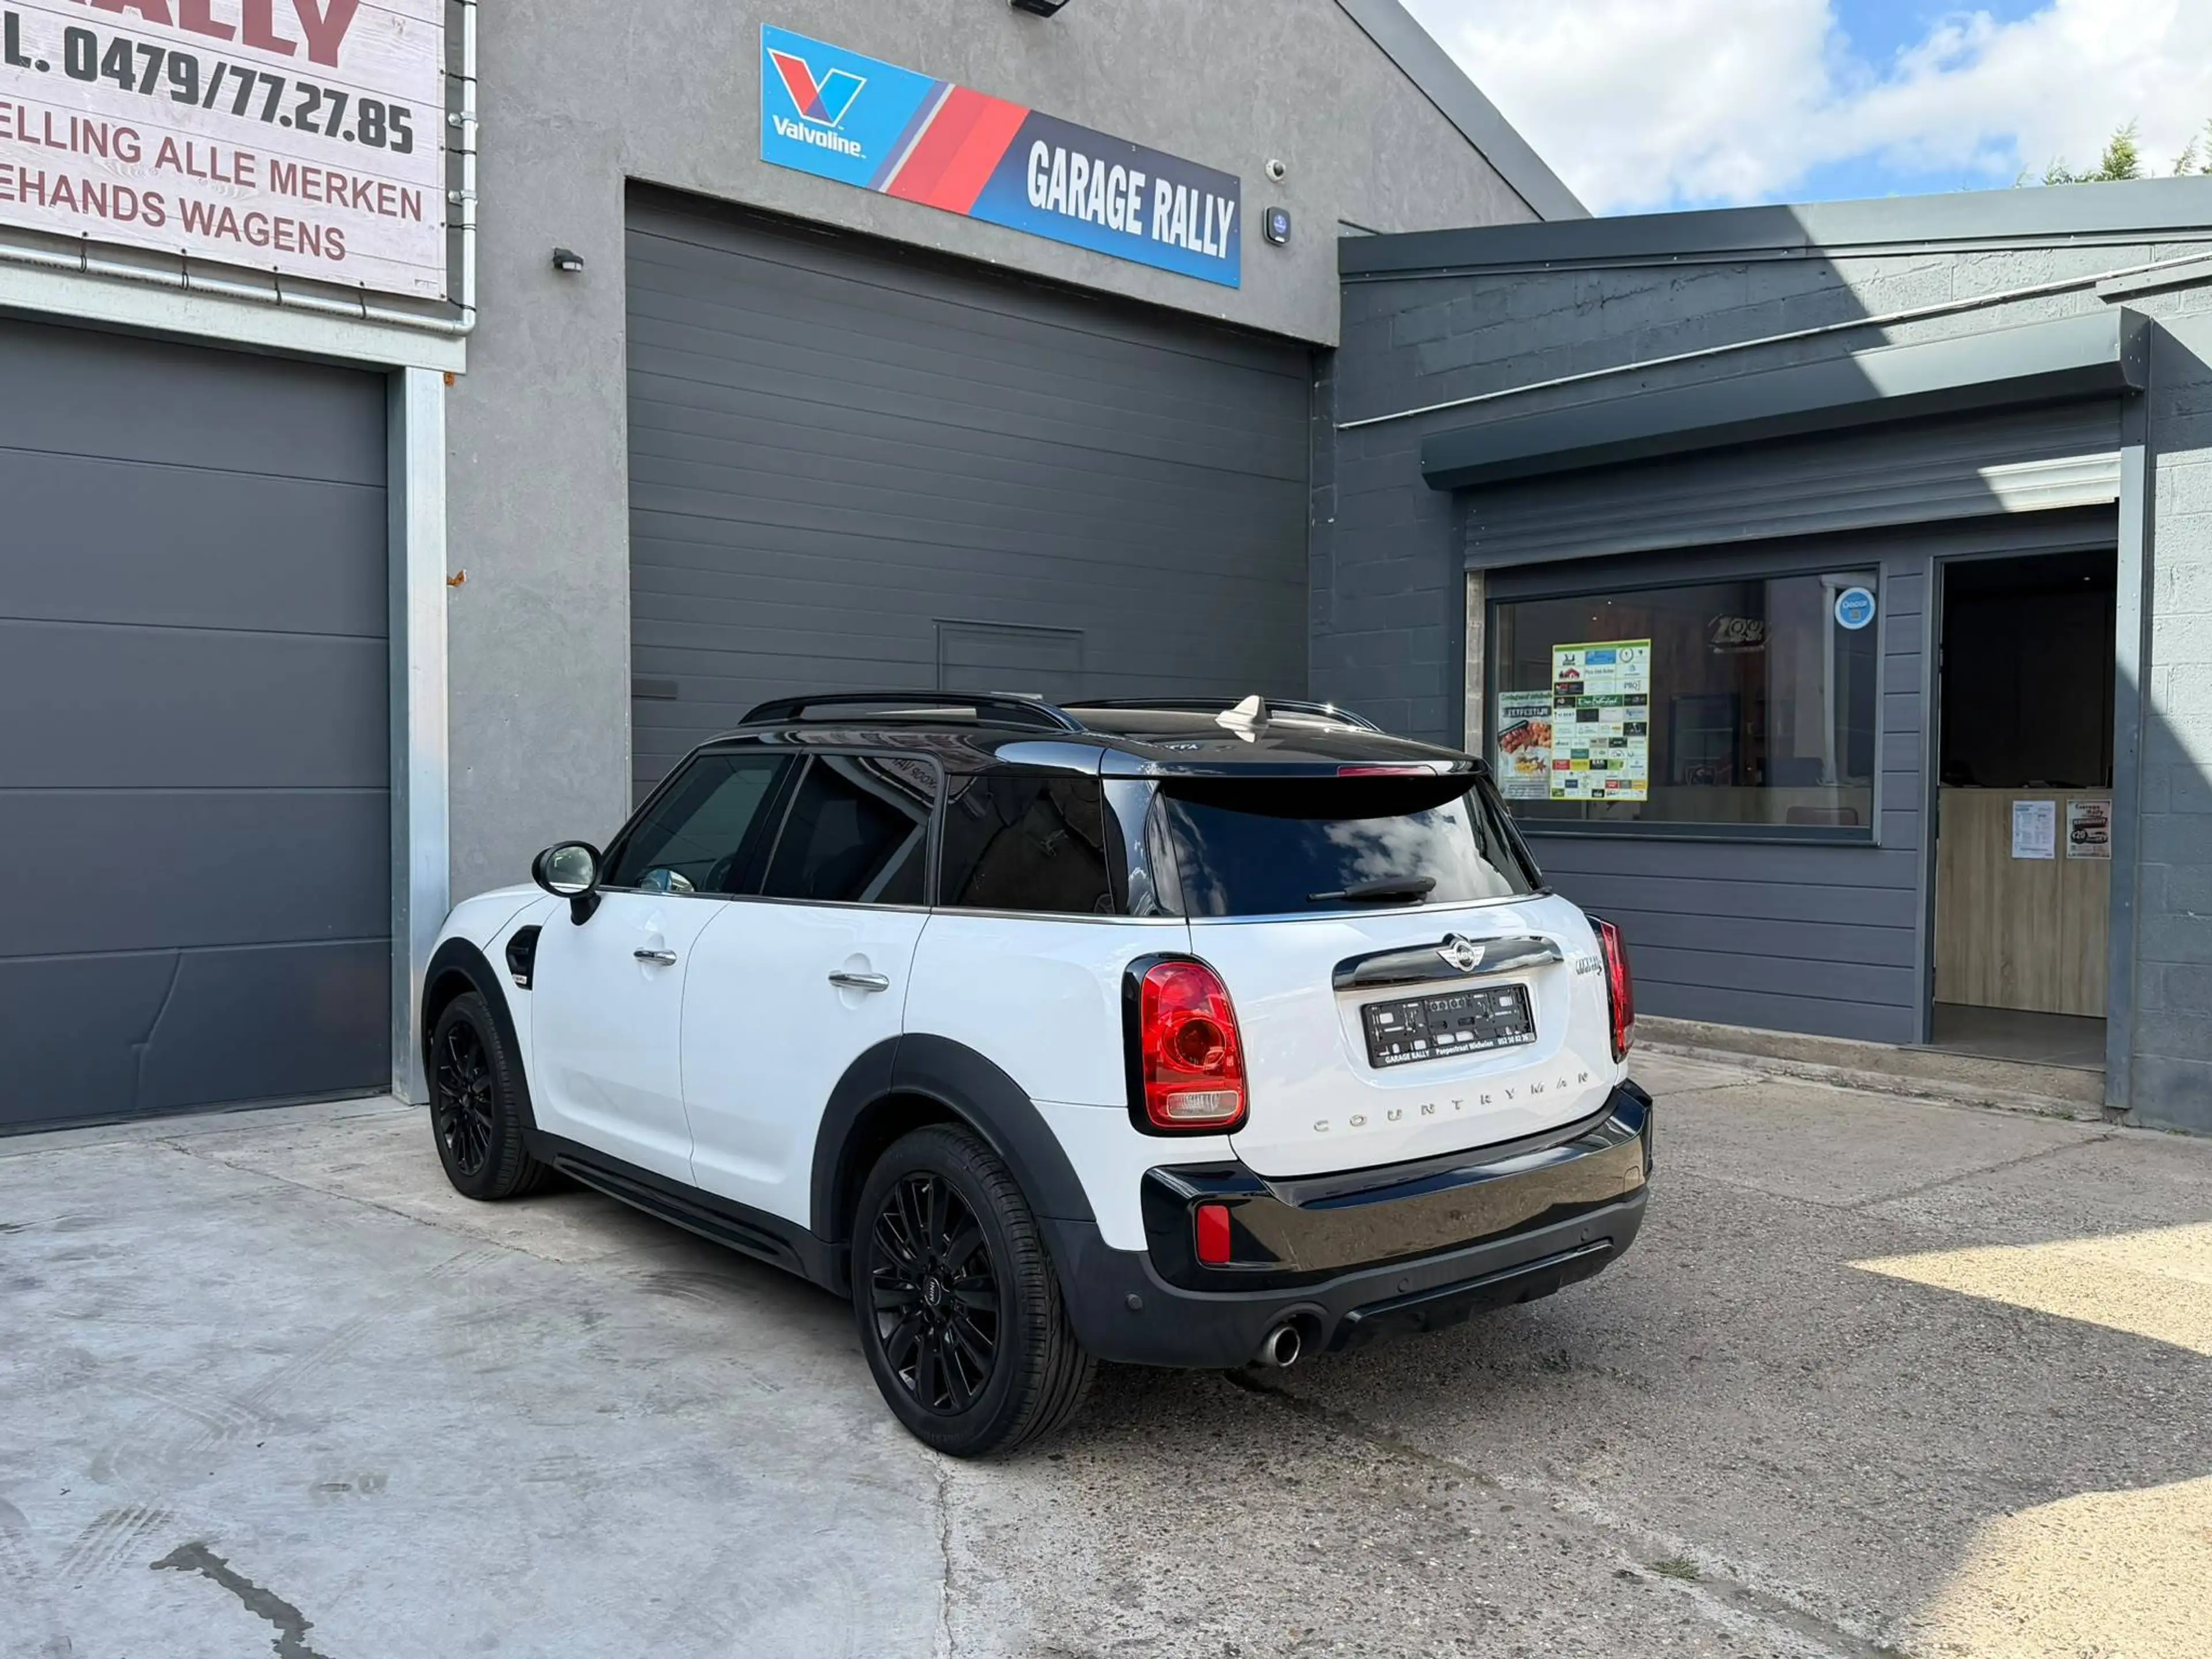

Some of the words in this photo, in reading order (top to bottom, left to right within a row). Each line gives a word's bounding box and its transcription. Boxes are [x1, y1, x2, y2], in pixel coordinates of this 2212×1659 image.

[65, 26, 412, 154] 0479/77.27.85
[772, 115, 862, 157] Valvoline
[155, 137, 256, 188] ALLE
[271, 160, 422, 222] MERKEN
[1028, 140, 1146, 236] GARAGE
[1153, 178, 1235, 259] RALLY
[179, 198, 346, 261] WAGENS
[1314, 1071, 1589, 1132] COUNTRYMAN
